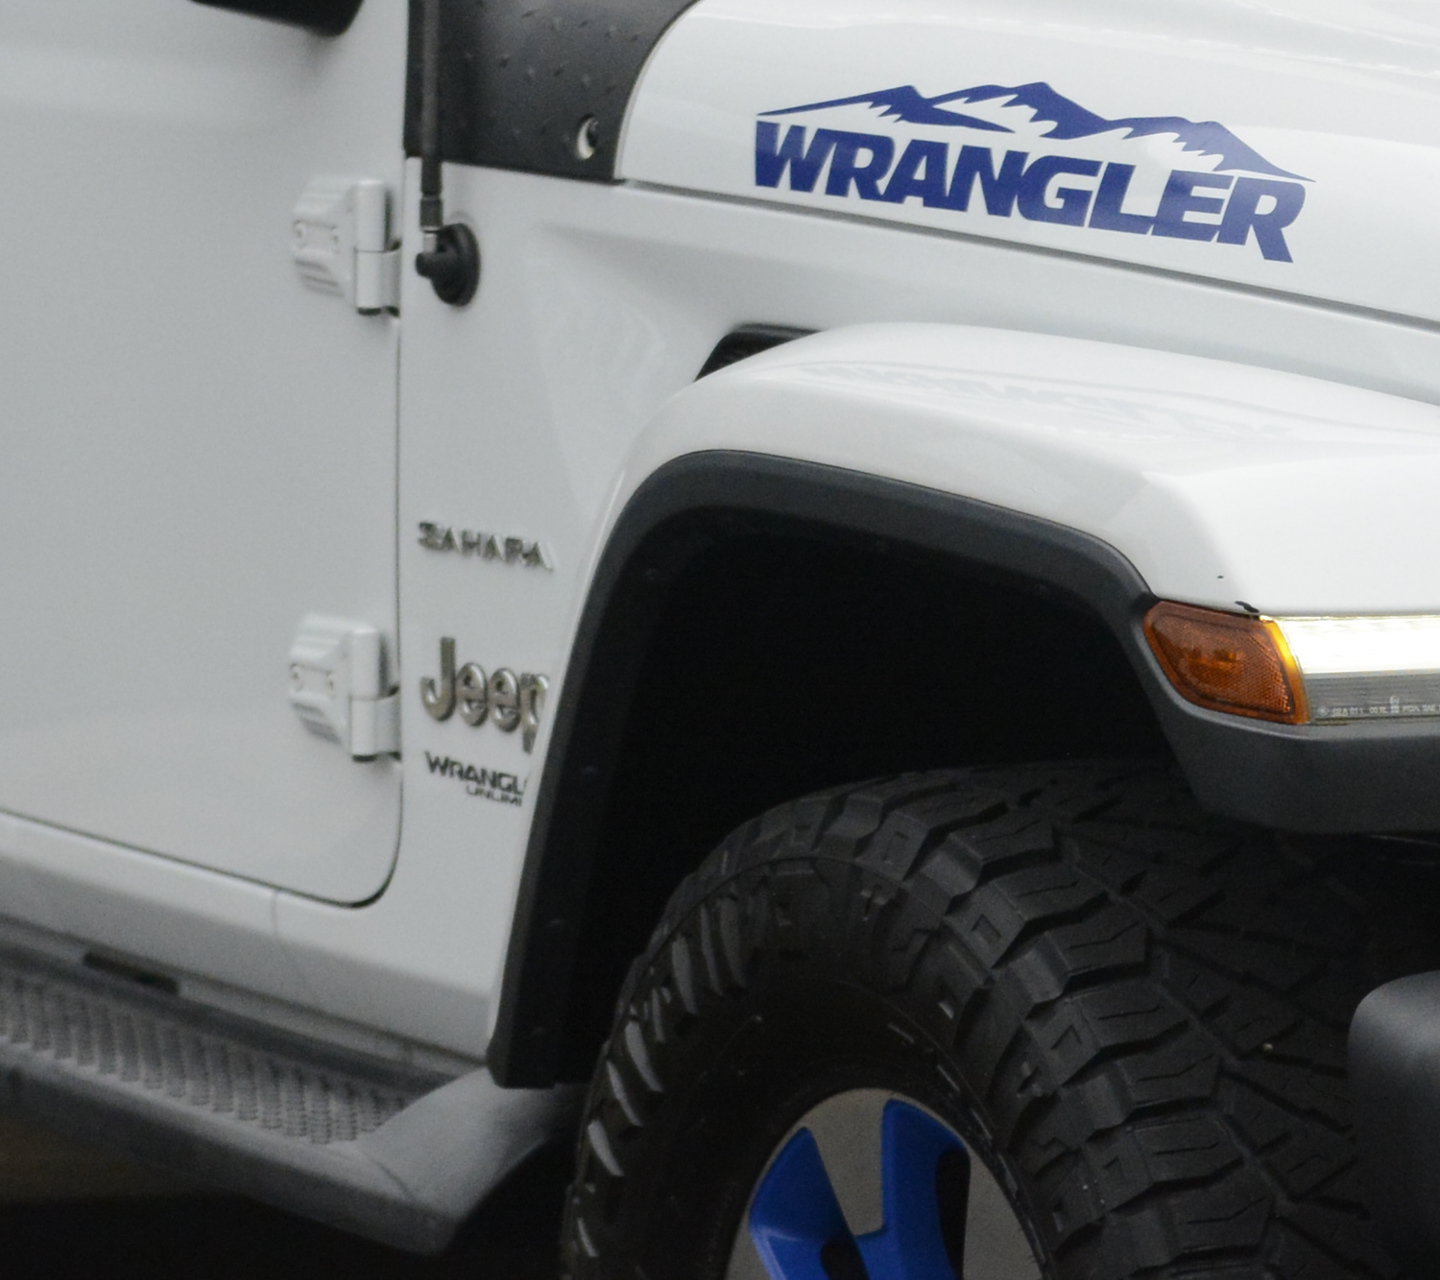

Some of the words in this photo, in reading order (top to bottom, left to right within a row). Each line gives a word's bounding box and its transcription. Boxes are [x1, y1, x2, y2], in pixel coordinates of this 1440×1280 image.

[755, 120, 1306, 262] WRANGLER
[417, 521, 556, 571] SAHARA
[419, 636, 550, 754] Jeep
[424, 750, 528, 796] WRANGL
